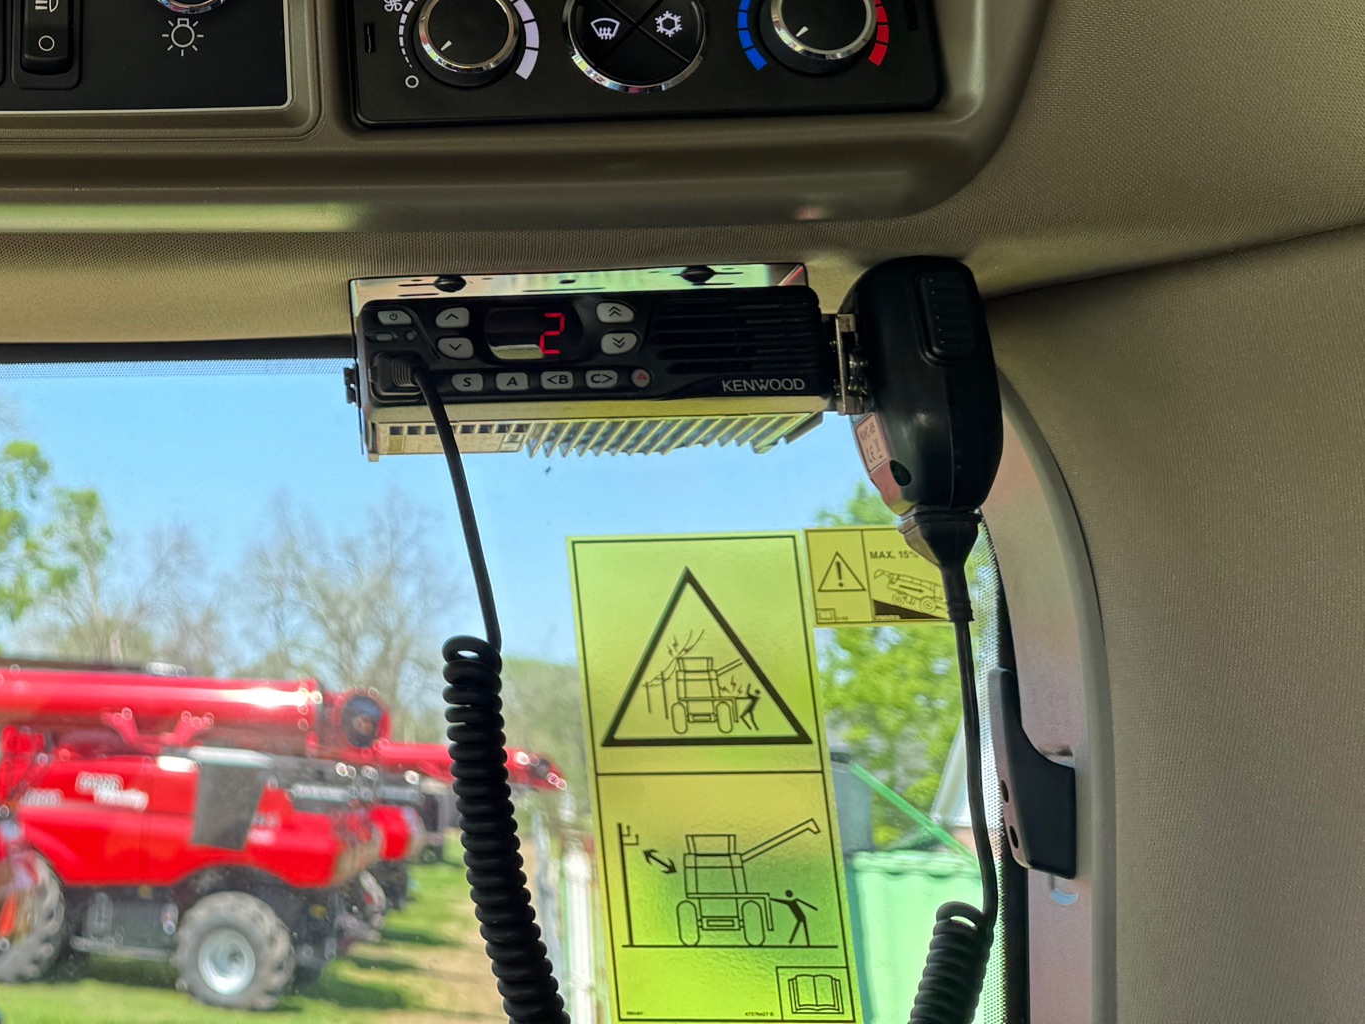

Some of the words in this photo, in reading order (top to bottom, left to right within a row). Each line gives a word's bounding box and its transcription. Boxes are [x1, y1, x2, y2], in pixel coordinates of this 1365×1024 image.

[540, 312, 566, 354] 2
[462, 376, 472, 387] S
[506, 376, 518, 387] A
[721, 378, 806, 392] KENWOOD
[870, 550, 896, 559] MAX.
